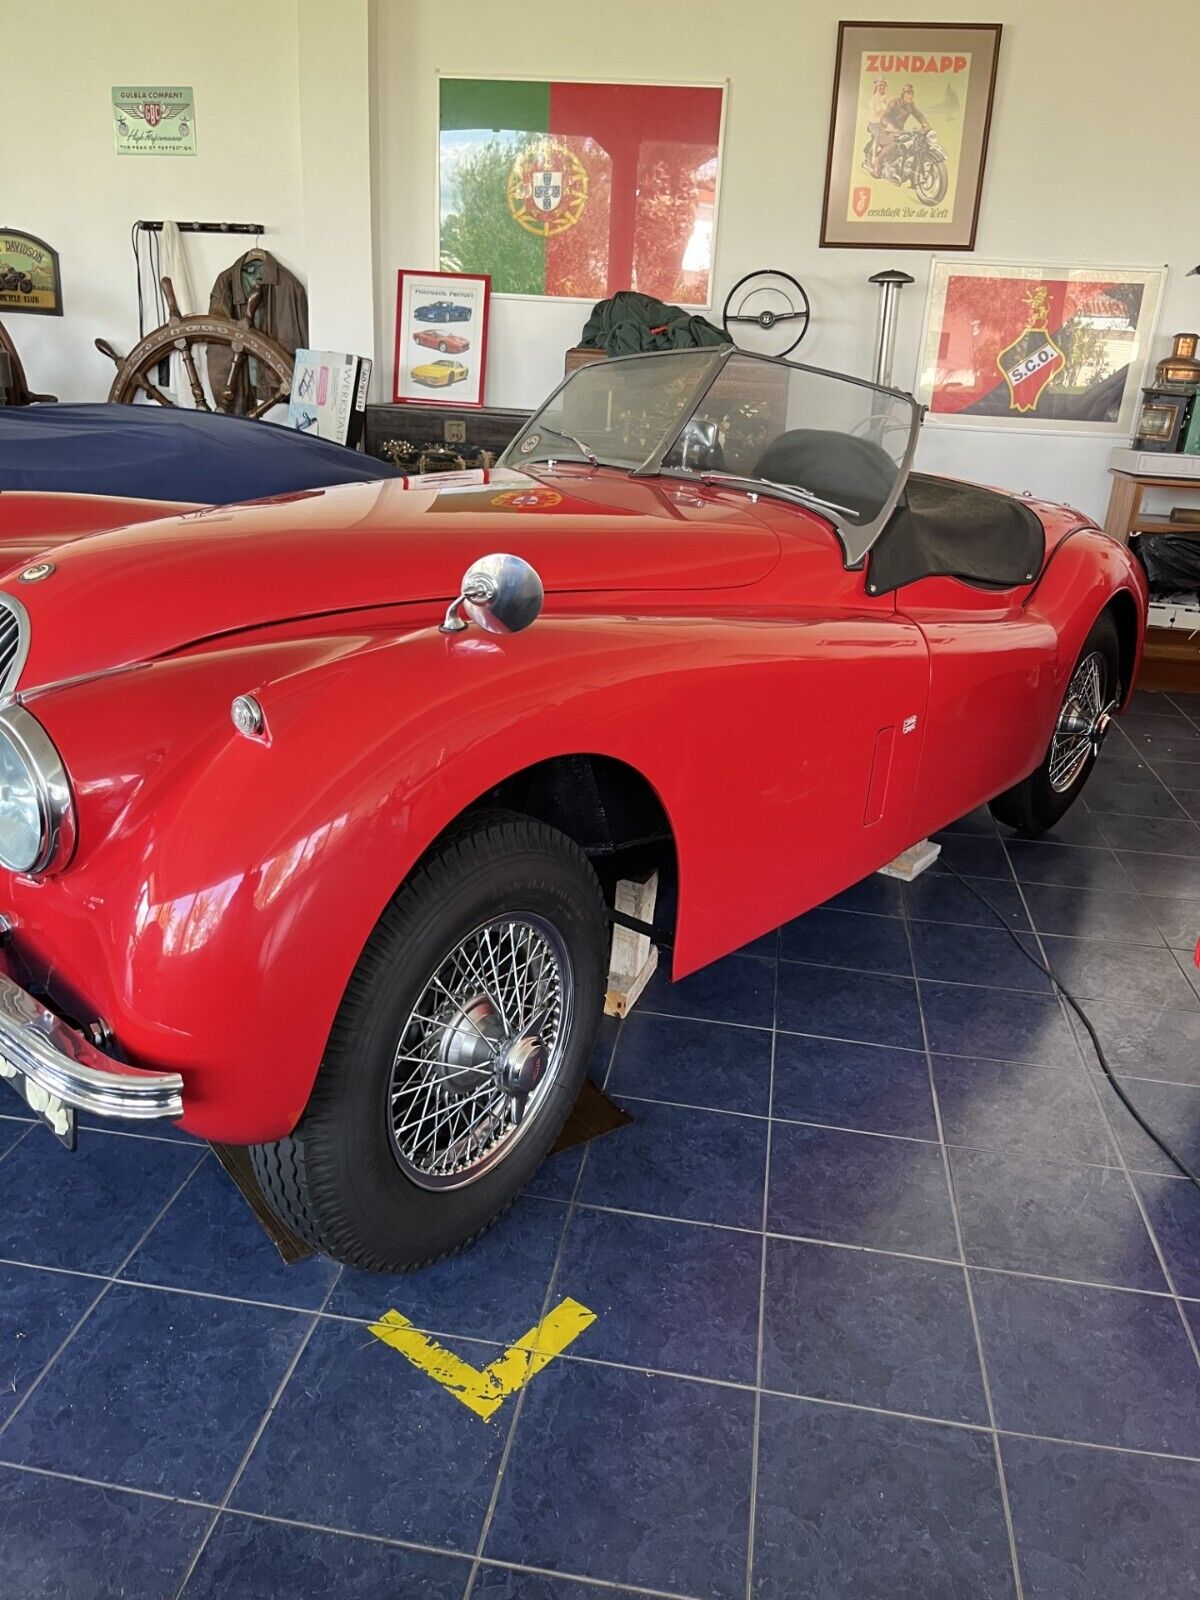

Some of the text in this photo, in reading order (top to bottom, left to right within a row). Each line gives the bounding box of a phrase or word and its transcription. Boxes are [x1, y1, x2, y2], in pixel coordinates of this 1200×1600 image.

[148, 91, 183, 99] COMPANY
[5, 240, 44, 263] DAVIDSON
[1011, 350, 1054, 382] S.C.O.
